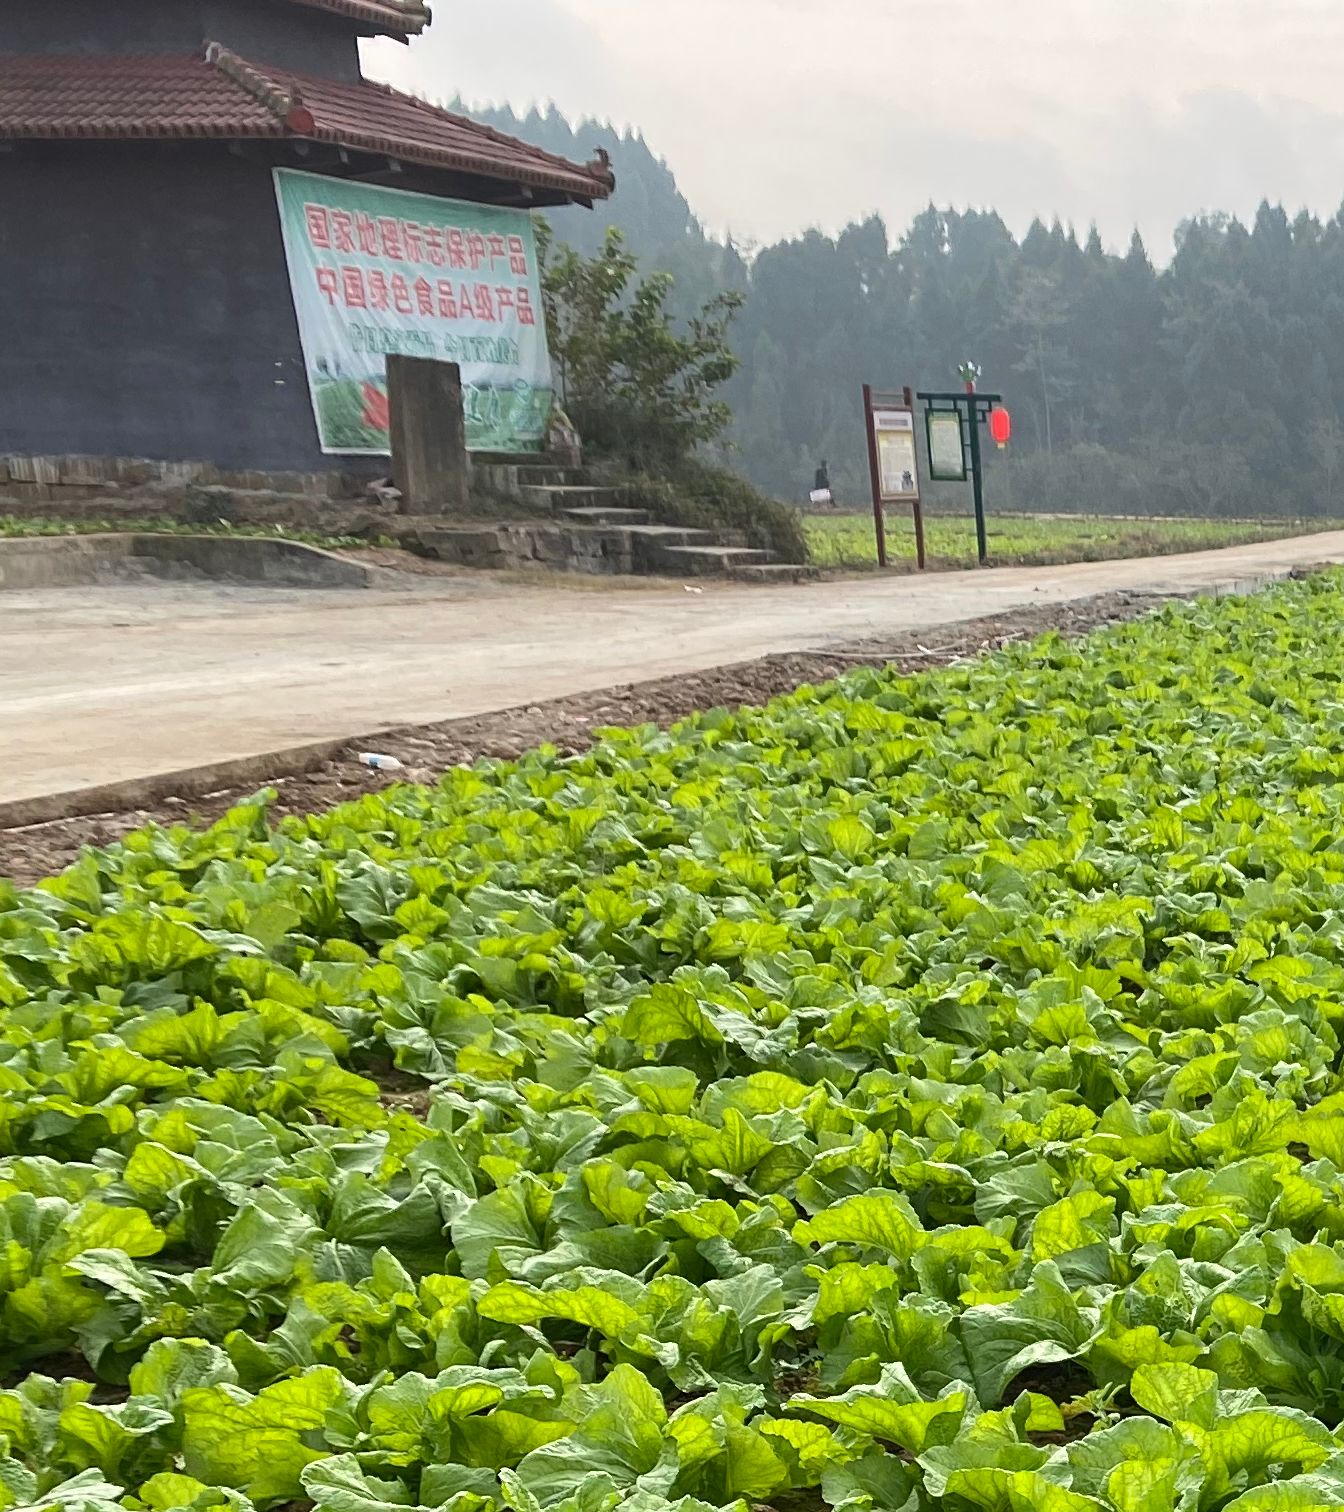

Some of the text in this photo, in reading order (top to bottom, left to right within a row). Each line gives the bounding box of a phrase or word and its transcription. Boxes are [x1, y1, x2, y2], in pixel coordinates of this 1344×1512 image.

[304, 203, 528, 276] 国家地理标志保护产品
[315, 265, 535, 326] 中国绿色食品A级产品
